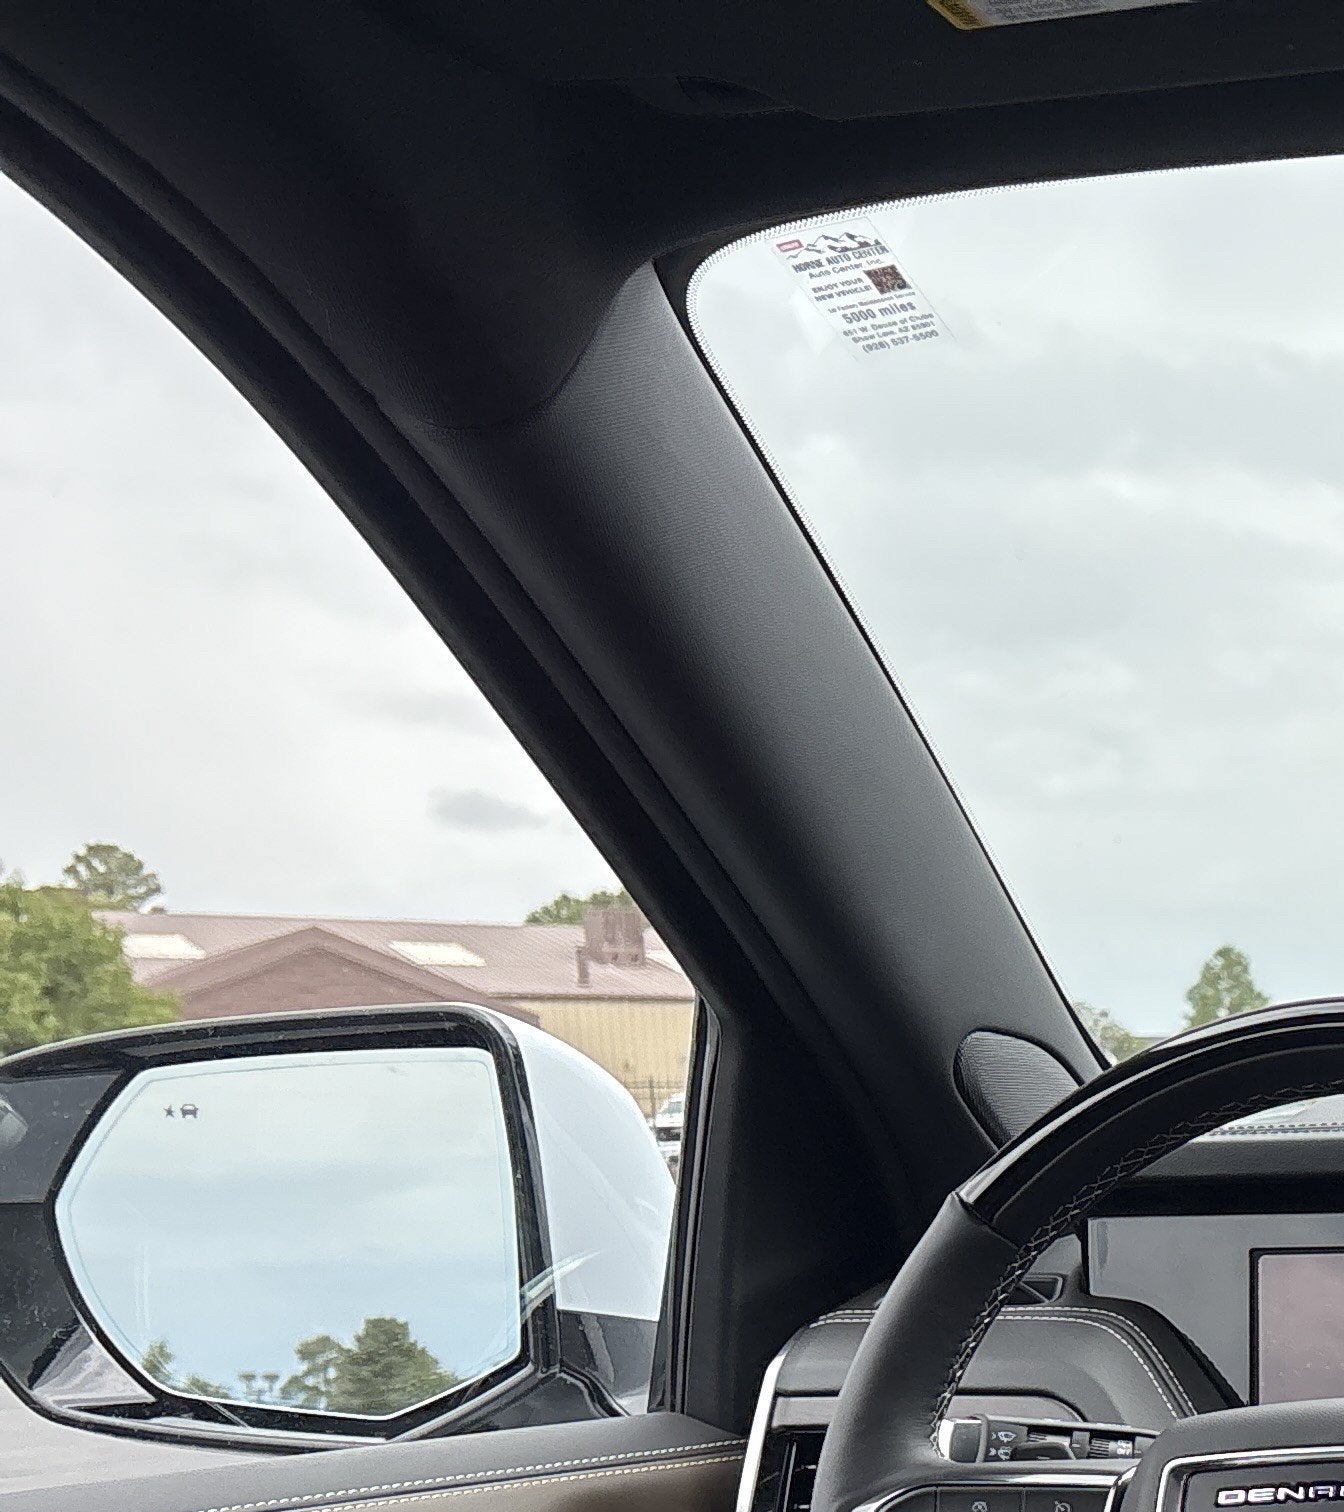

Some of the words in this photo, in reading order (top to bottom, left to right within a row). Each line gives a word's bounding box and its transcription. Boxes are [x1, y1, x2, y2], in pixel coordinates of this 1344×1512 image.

[826, 253, 851, 266] AUTO
[852, 245, 889, 260] CENTER
[809, 270, 831, 279] Auto
[812, 282, 838, 294] ENJOY
[838, 277, 864, 288] YOUR
[814, 292, 834, 303] NEW
[842, 308, 877, 325] 5000
[878, 301, 917, 317] miles
[899, 317, 908, 325] of
[851, 335, 876, 344] Show
[862, 339, 891, 354] (928)
